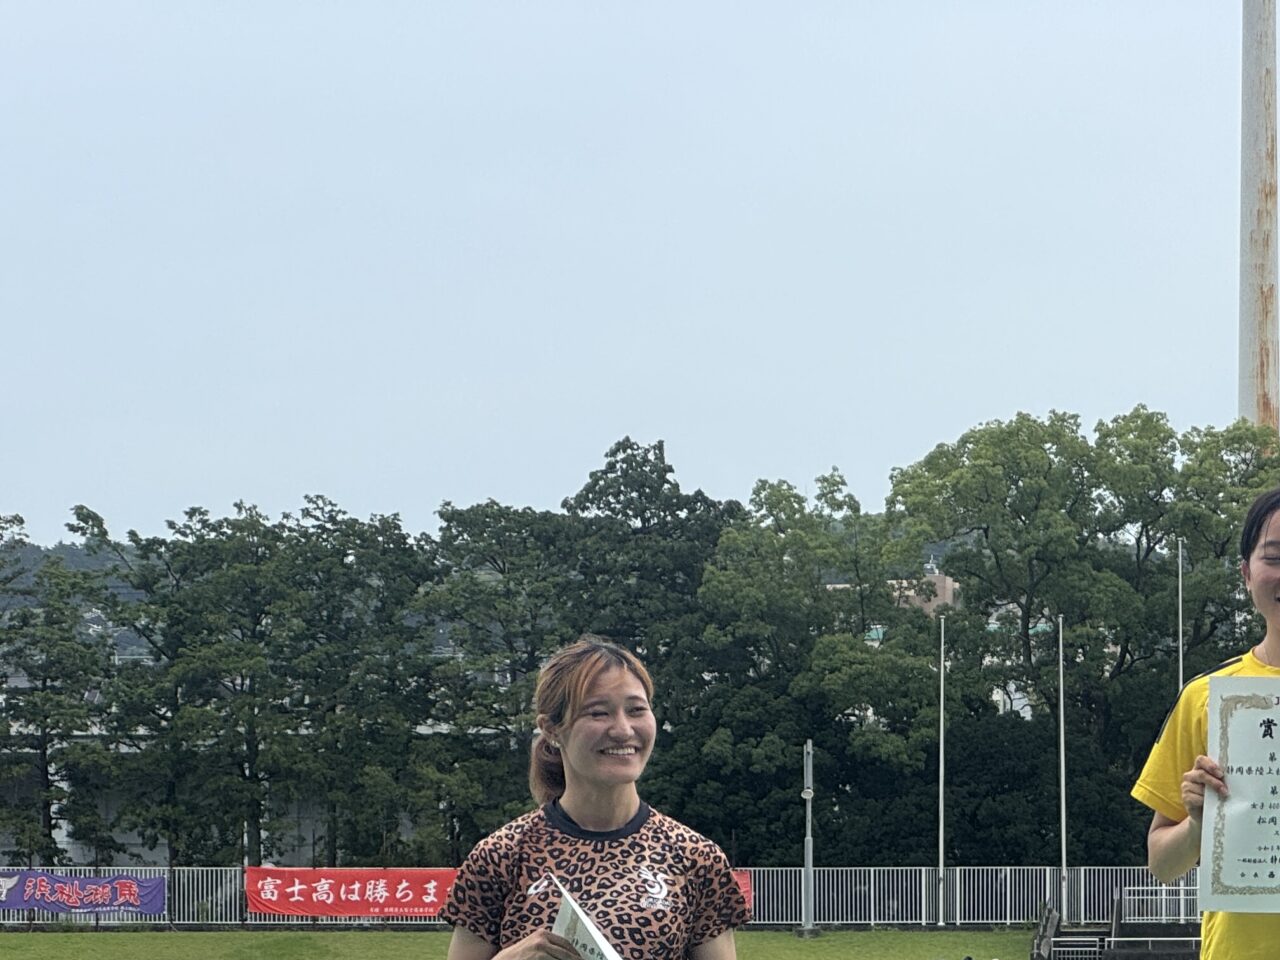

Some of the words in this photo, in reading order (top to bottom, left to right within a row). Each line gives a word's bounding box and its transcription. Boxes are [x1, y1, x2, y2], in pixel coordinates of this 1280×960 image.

[257, 876, 451, 903] 富士高は勝ちま
